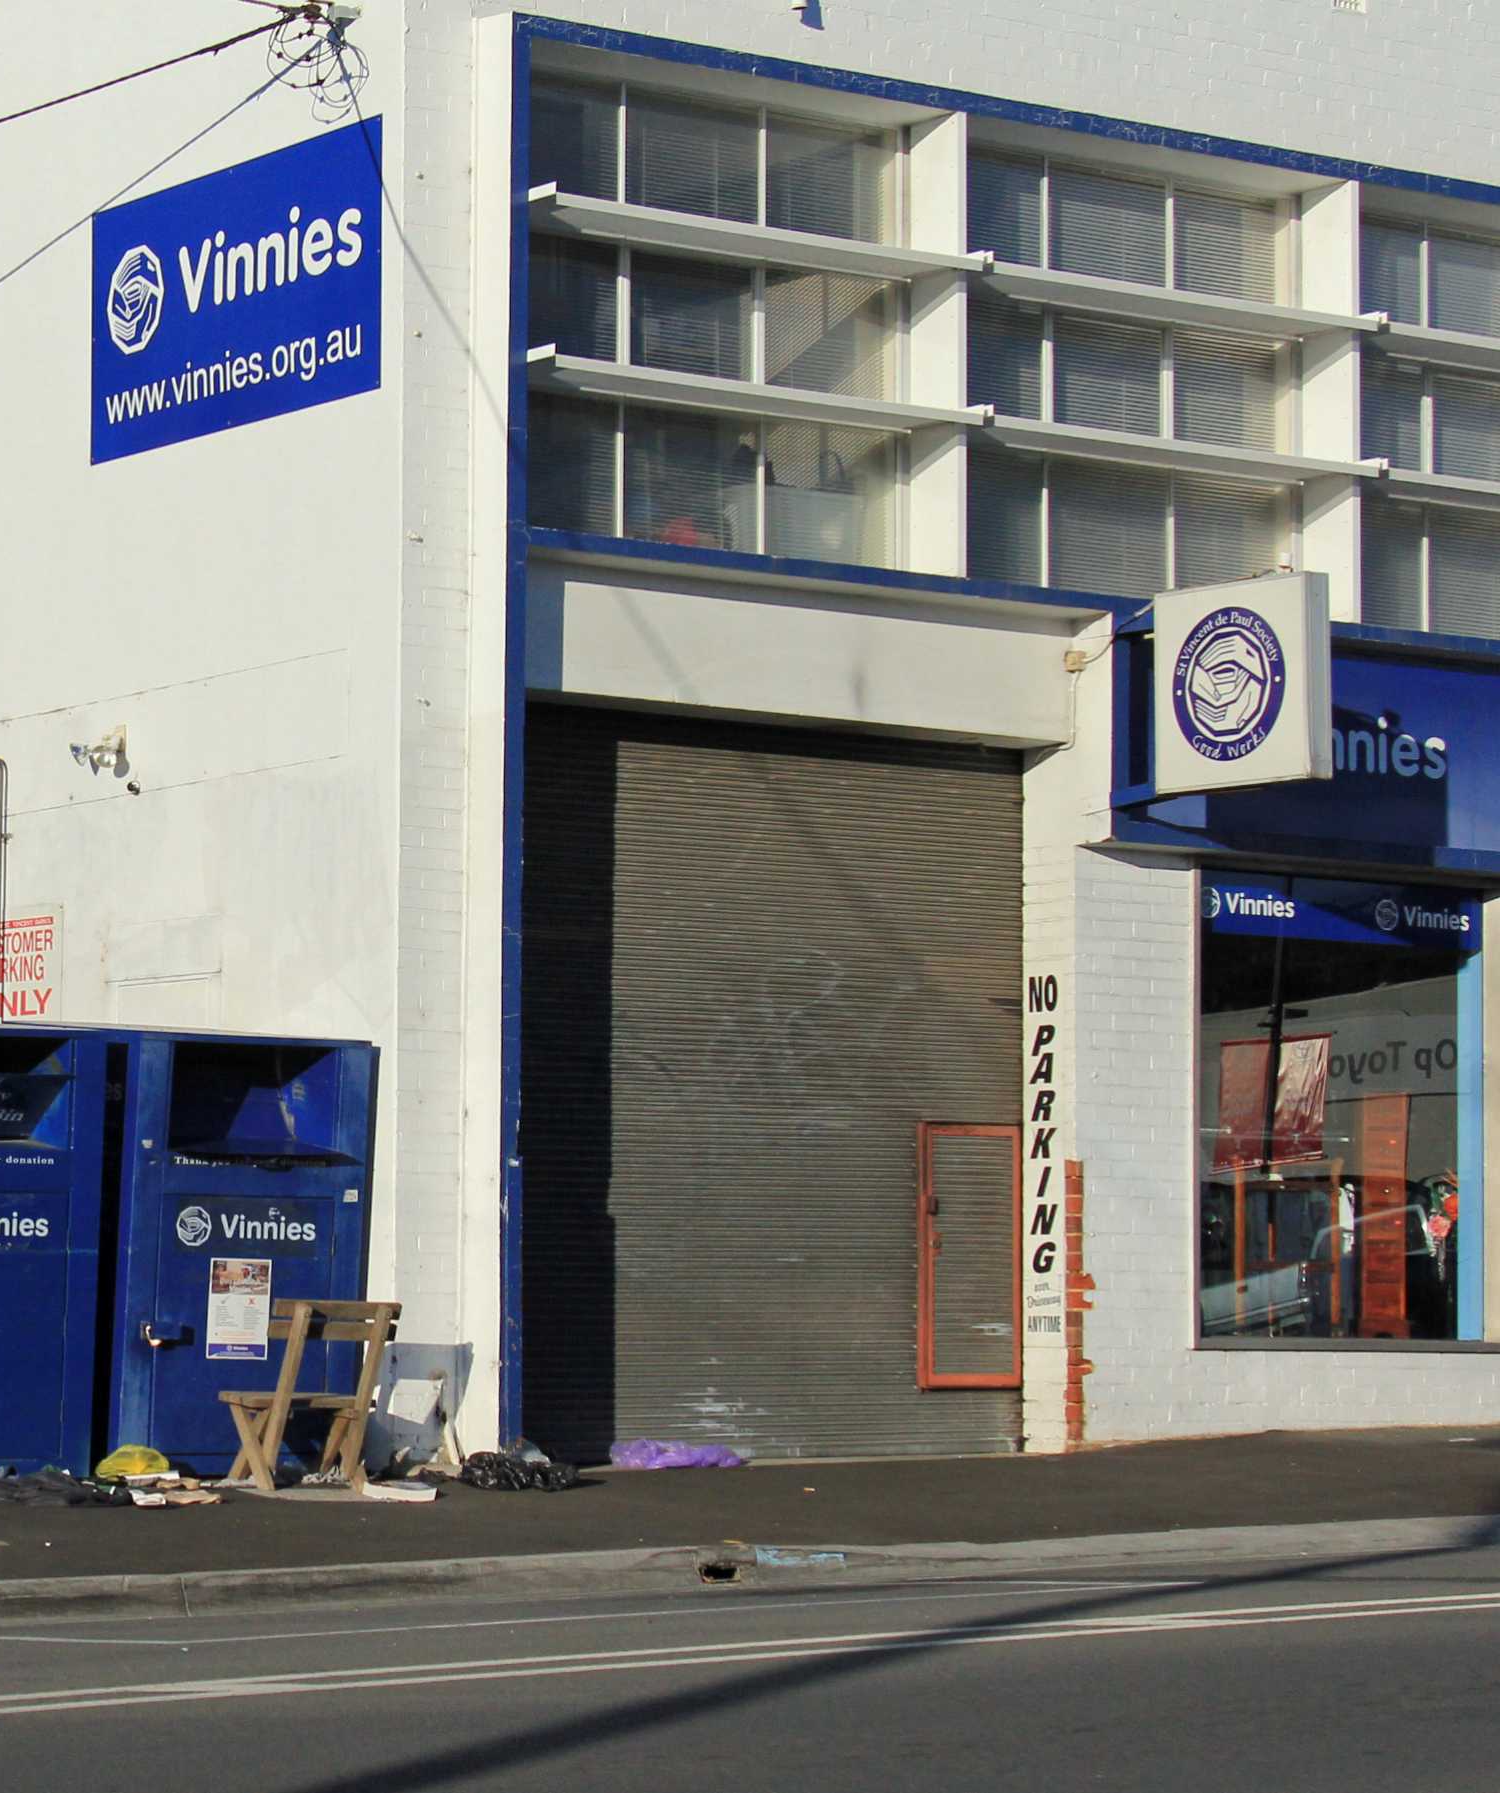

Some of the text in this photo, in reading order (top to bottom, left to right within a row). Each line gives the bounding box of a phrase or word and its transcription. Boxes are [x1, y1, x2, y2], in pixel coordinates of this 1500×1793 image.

[178, 205, 363, 314] Vinnies
[105, 323, 362, 425] www.vinnies.org.au
[1177, 611, 1279, 677] St Vincent de Paul Society
[1192, 726, 1266, 759] Good Works
[1225, 891, 1295, 918] Vinnies
[1403, 905, 1470, 931] Vinnies
[1028, 974, 1058, 1013] NO
[5, 1155, 55, 1166] donation
[1028, 1024, 1059, 1274] PARKING
[220, 1213, 317, 1242] Vinnies
[1027, 1315, 1061, 1333] ANYTIME
